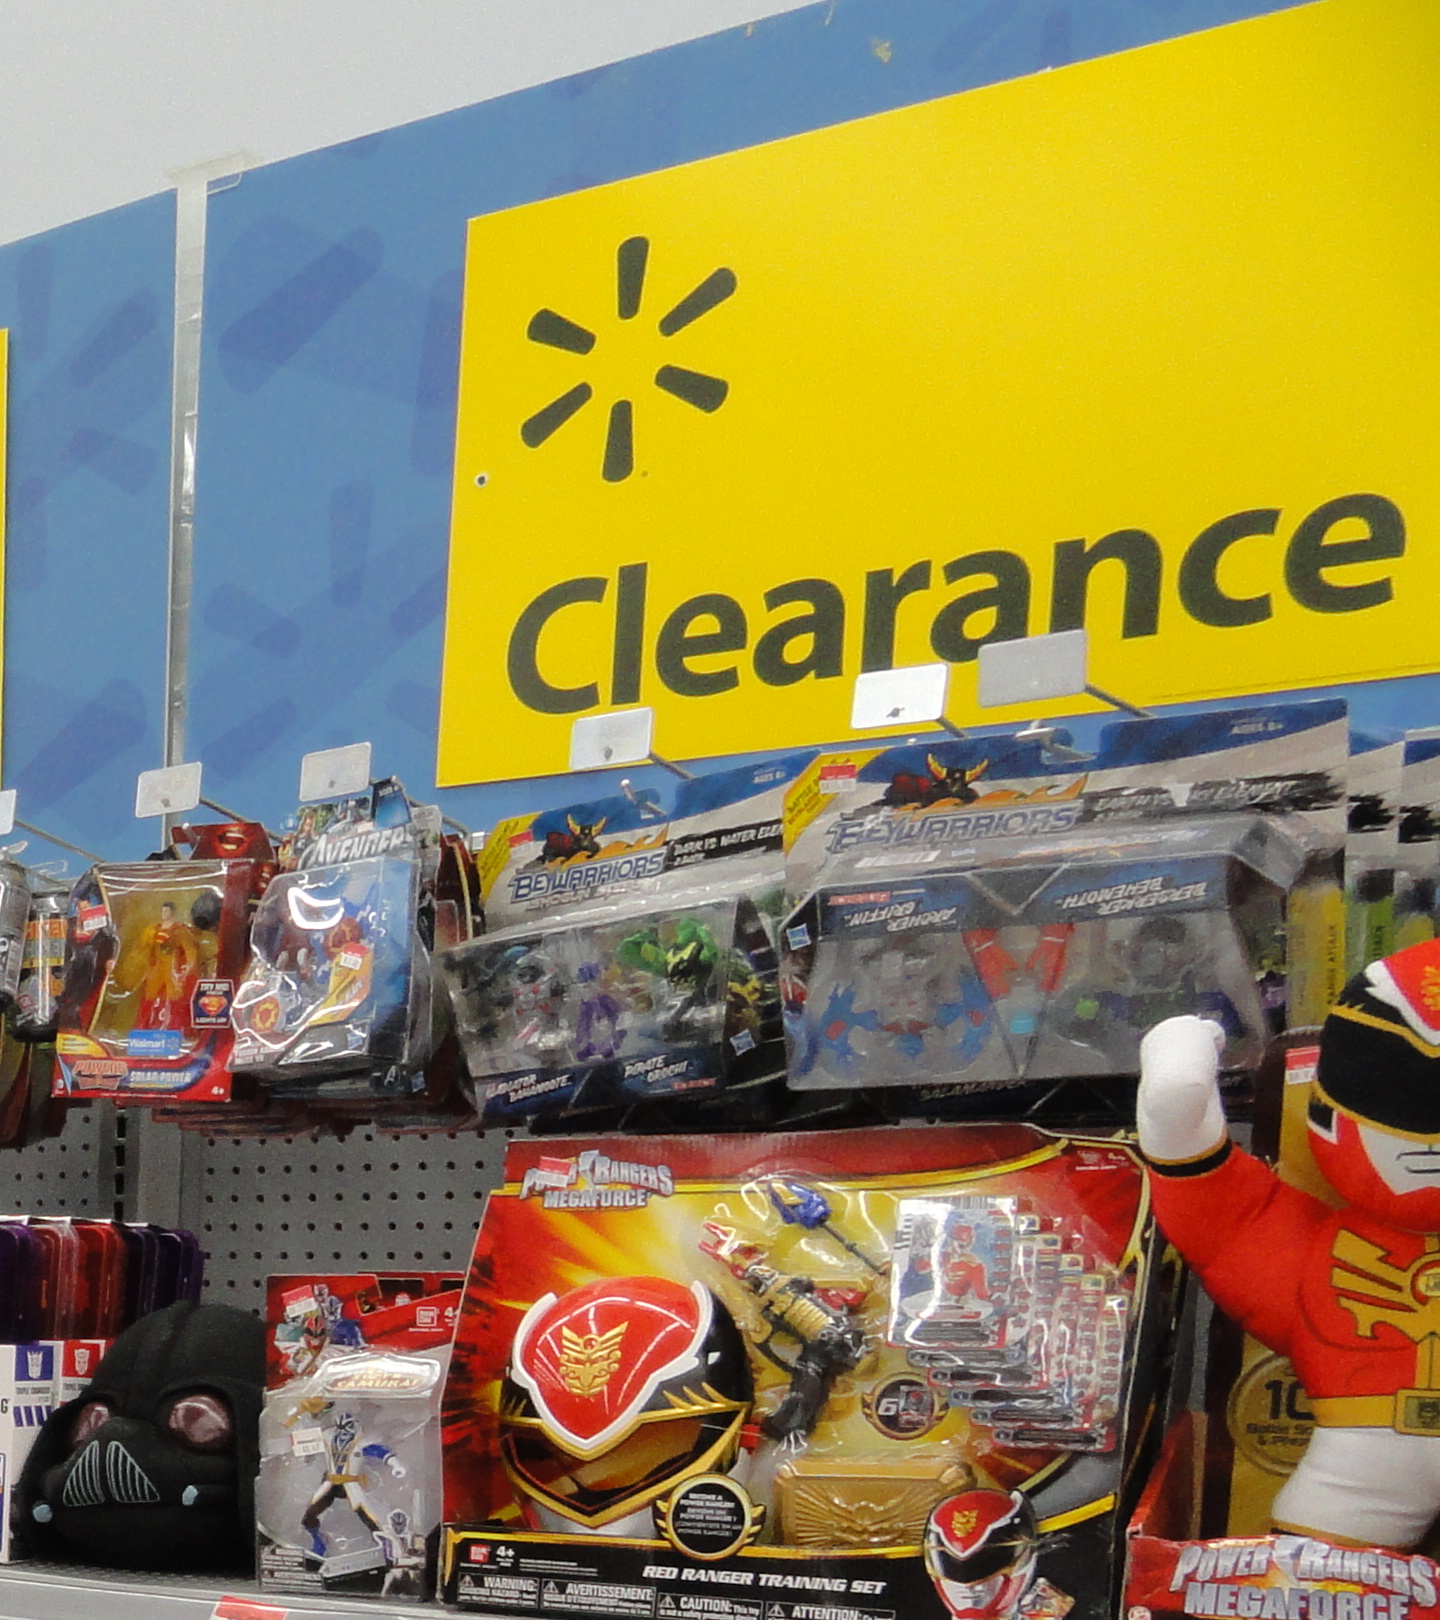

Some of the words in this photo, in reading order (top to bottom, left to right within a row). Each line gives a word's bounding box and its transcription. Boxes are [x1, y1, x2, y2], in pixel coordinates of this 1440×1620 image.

[506, 493, 1406, 714] Clearance
[510, 850, 667, 901] BEYWARRIORS
[129, 1038, 166, 1052] Walmart
[544, 1188, 650, 1210] MEGAFORCE
[497, 1545, 515, 1558] 4+
[643, 1565, 678, 1579] RED
[684, 1568, 755, 1586] RANGER
[758, 1573, 849, 1591] TRAINING
[852, 1579, 886, 1594] SET
[1170, 1546, 1272, 1592] POWER
[1298, 1540, 1439, 1607] RANGERS
[484, 1576, 538, 1592] WARNING:
[566, 1582, 656, 1600] AVERTISSEMENT:
[680, 1597, 732, 1612] CAUTION:
